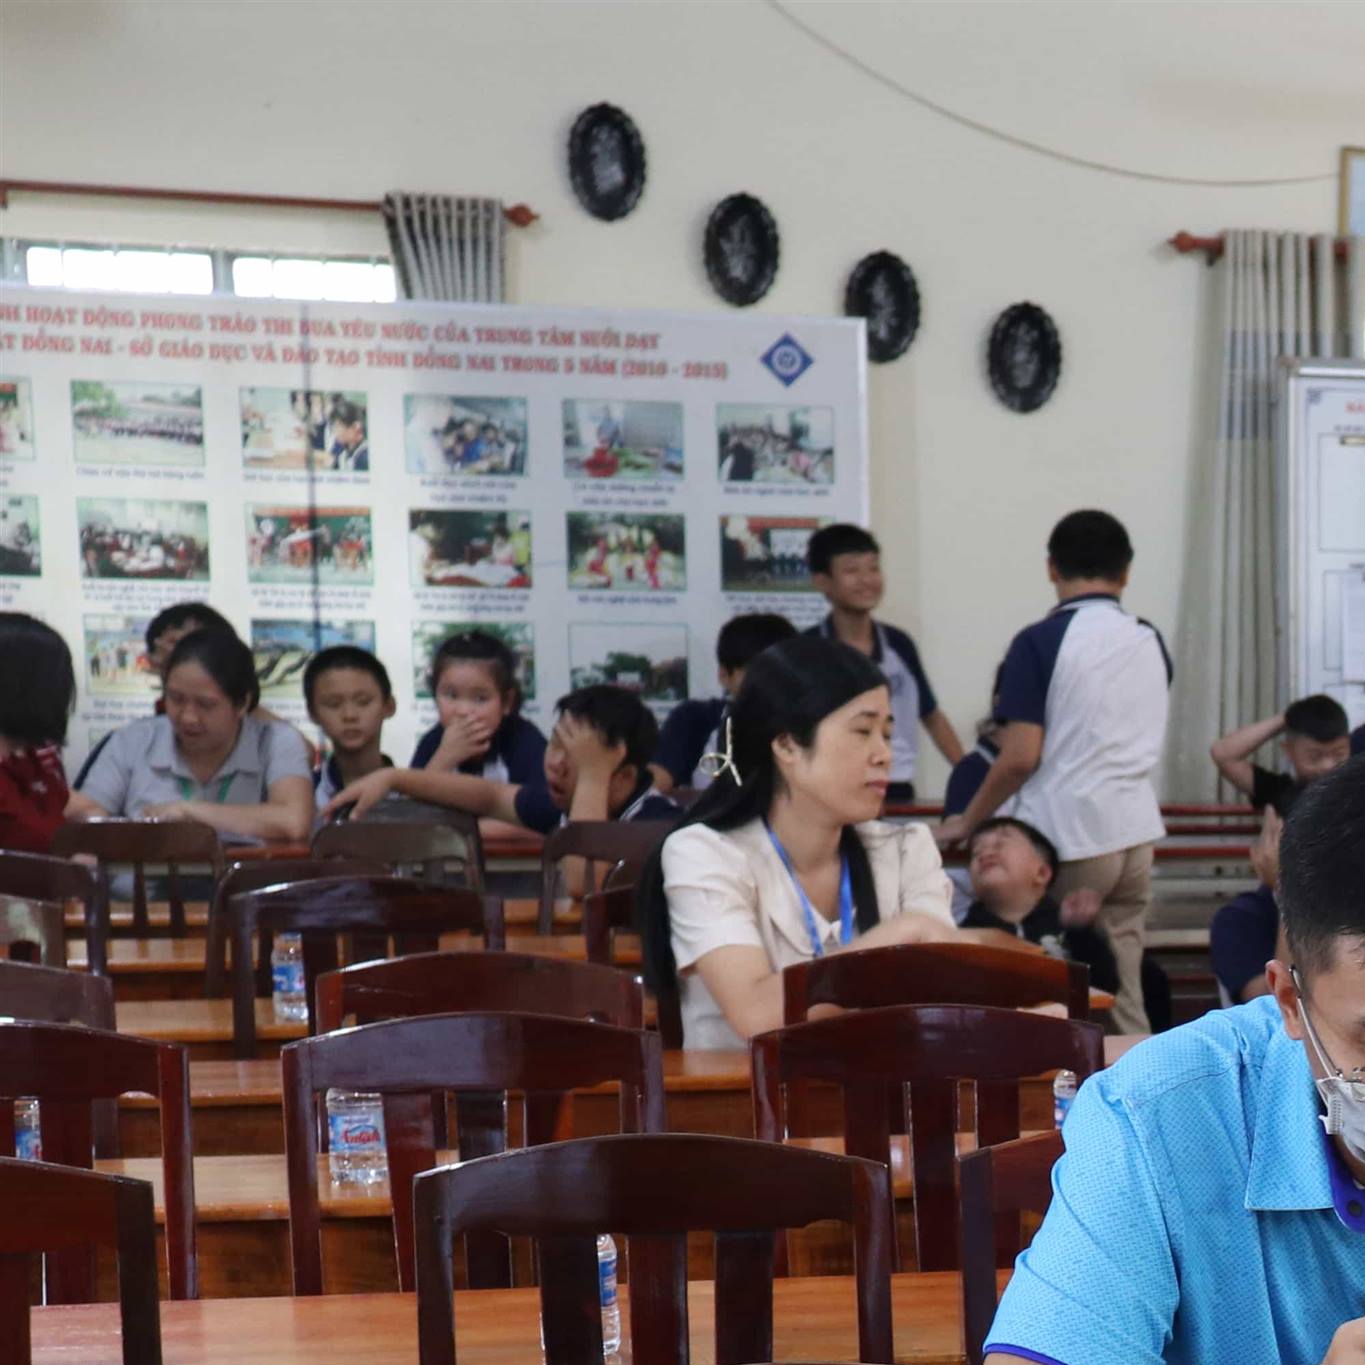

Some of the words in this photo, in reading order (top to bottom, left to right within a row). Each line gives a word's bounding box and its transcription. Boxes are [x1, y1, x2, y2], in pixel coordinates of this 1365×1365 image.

[26, 306, 77, 327] HOẠT
[140, 312, 200, 331] PHONG
[262, 316, 293, 334] THI
[474, 326, 532, 346] TRUNG
[80, 336, 112, 355] NAI
[159, 338, 201, 359] GIÁO
[466, 353, 496, 372] NAI
[502, 354, 558, 374] TRONG
